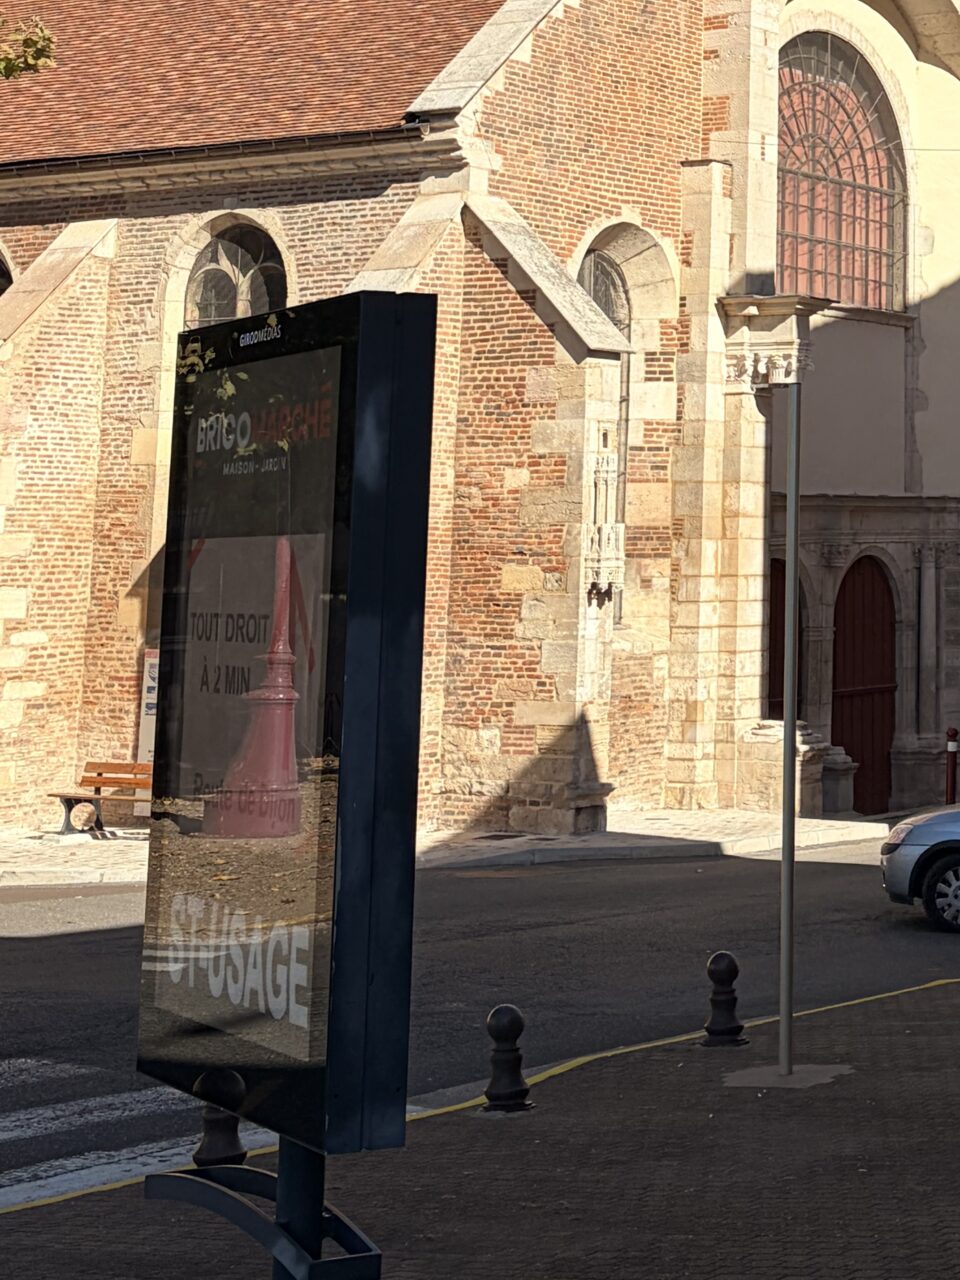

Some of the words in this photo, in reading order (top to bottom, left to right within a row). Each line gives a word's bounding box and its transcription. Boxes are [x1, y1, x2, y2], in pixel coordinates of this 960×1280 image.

[222, 459, 255, 476] MAISON
[191, 612, 222, 642] TOUT
[225, 613, 270, 644] DROIT
[200, 655, 210, 693] À
[213, 665, 221, 694] 2
[224, 665, 251, 696] MIN
[193, 772, 233, 812] Route
[238, 781, 254, 816] de
[259, 785, 296, 830] Dijon
[168, 894, 310, 1029] ST-USAGE
